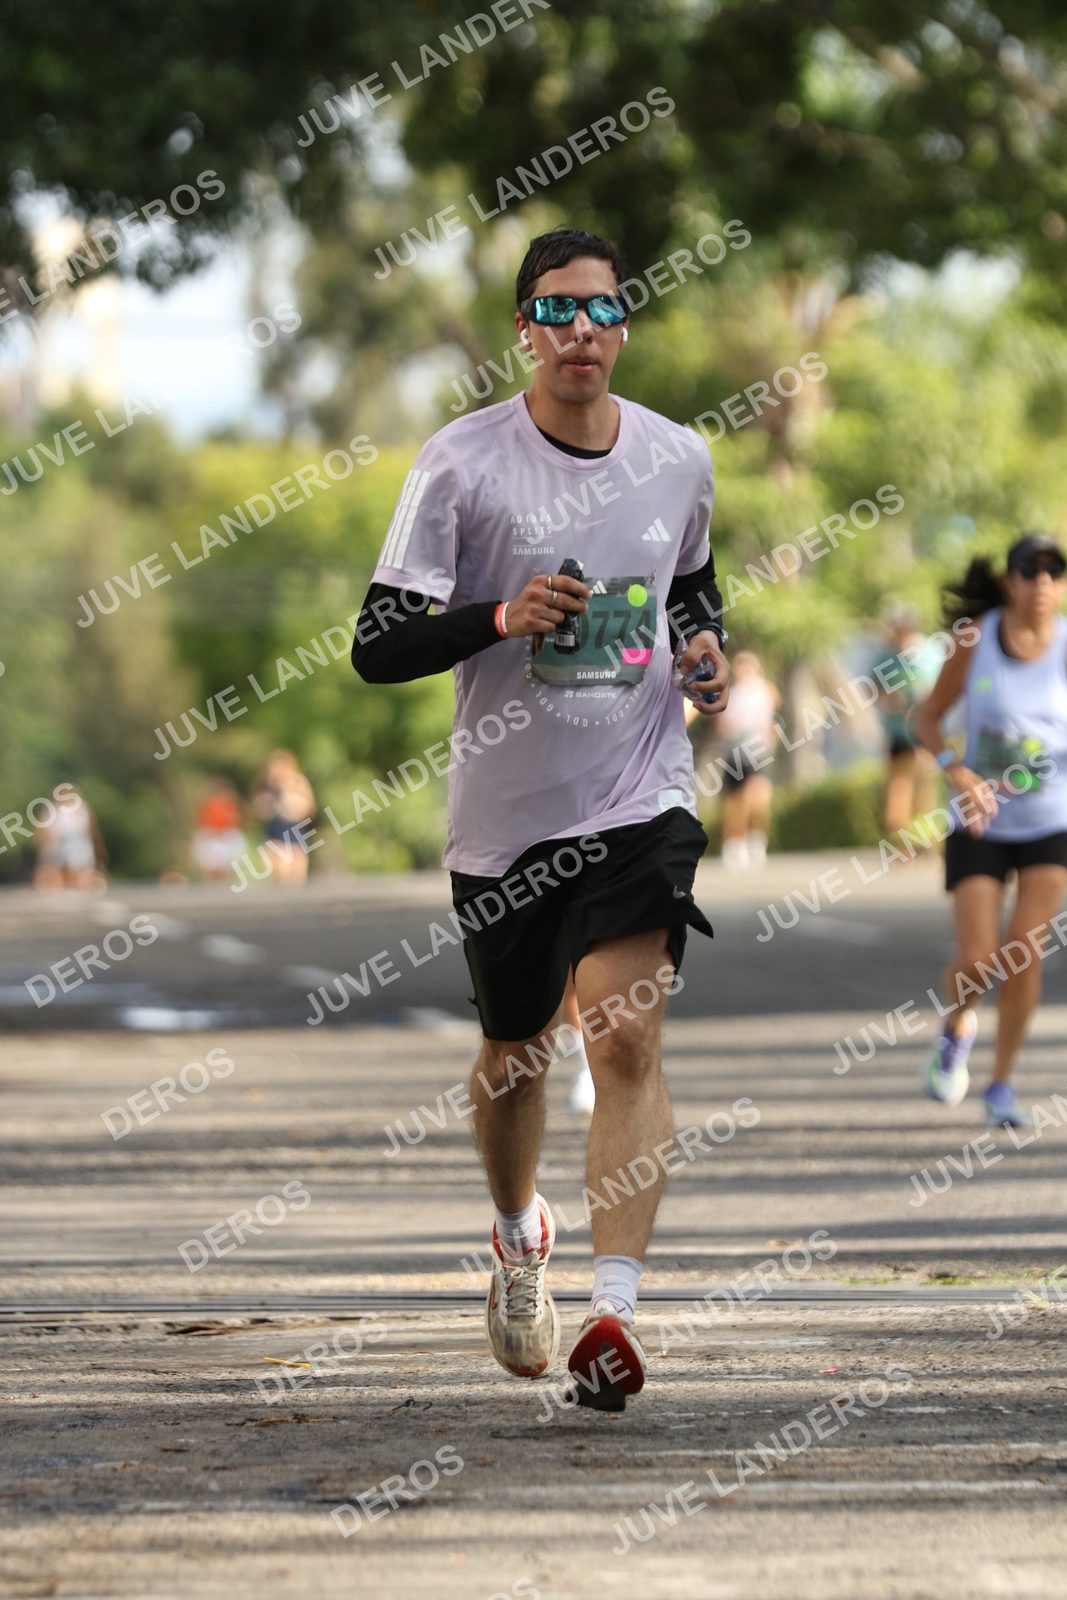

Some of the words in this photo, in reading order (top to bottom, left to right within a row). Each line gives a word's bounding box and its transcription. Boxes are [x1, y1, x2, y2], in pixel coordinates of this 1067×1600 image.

[510, 514, 552, 525] ADIDAS
[512, 546, 555, 556] SAMSUNG
[576, 671, 617, 680] SAMSUNG
